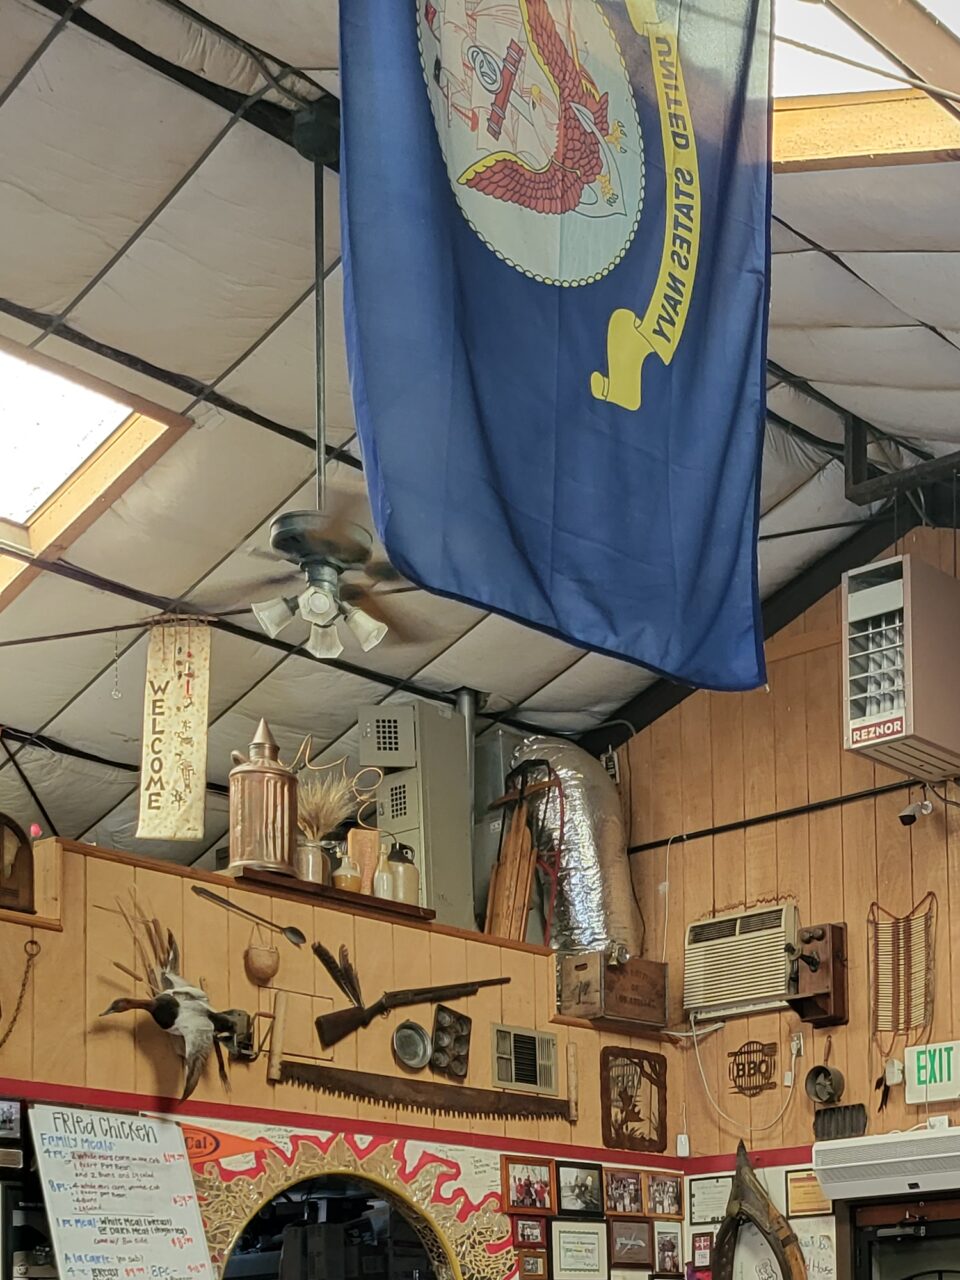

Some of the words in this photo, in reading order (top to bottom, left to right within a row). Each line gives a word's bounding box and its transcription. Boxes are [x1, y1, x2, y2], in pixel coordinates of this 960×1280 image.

[145, 680, 171, 811] WELCOME
[852, 720, 902, 742] REZNOR
[736, 1060, 770, 1080] BBQ
[916, 1045, 954, 1087] EXIT
